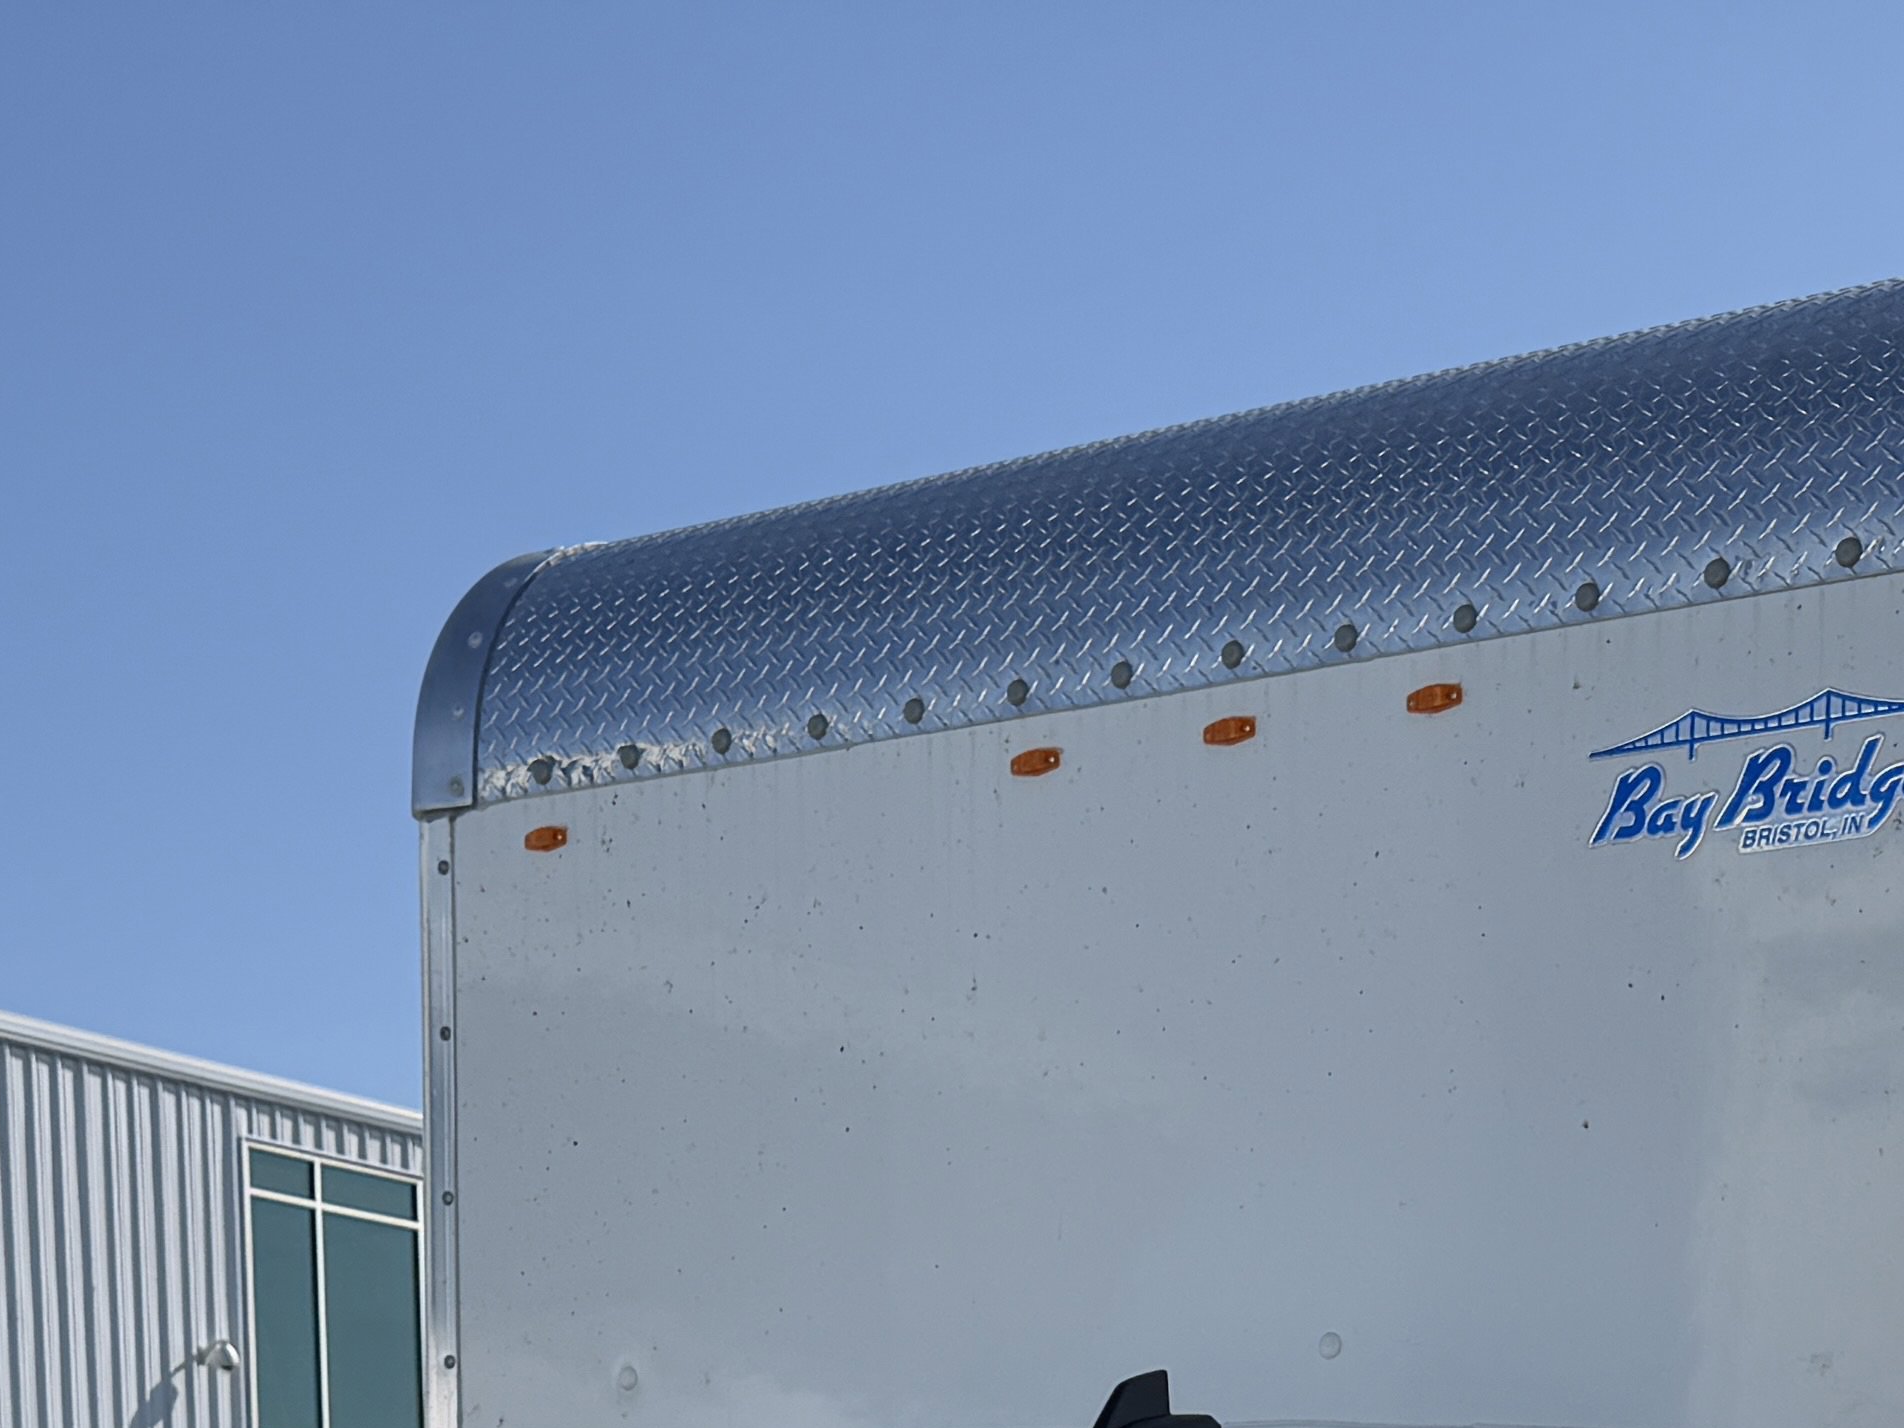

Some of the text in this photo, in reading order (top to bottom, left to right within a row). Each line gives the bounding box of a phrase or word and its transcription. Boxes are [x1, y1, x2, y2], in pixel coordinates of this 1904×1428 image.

[1590, 765, 1716, 859] Bay
[1741, 813, 1865, 849] BRISTOL, IN
